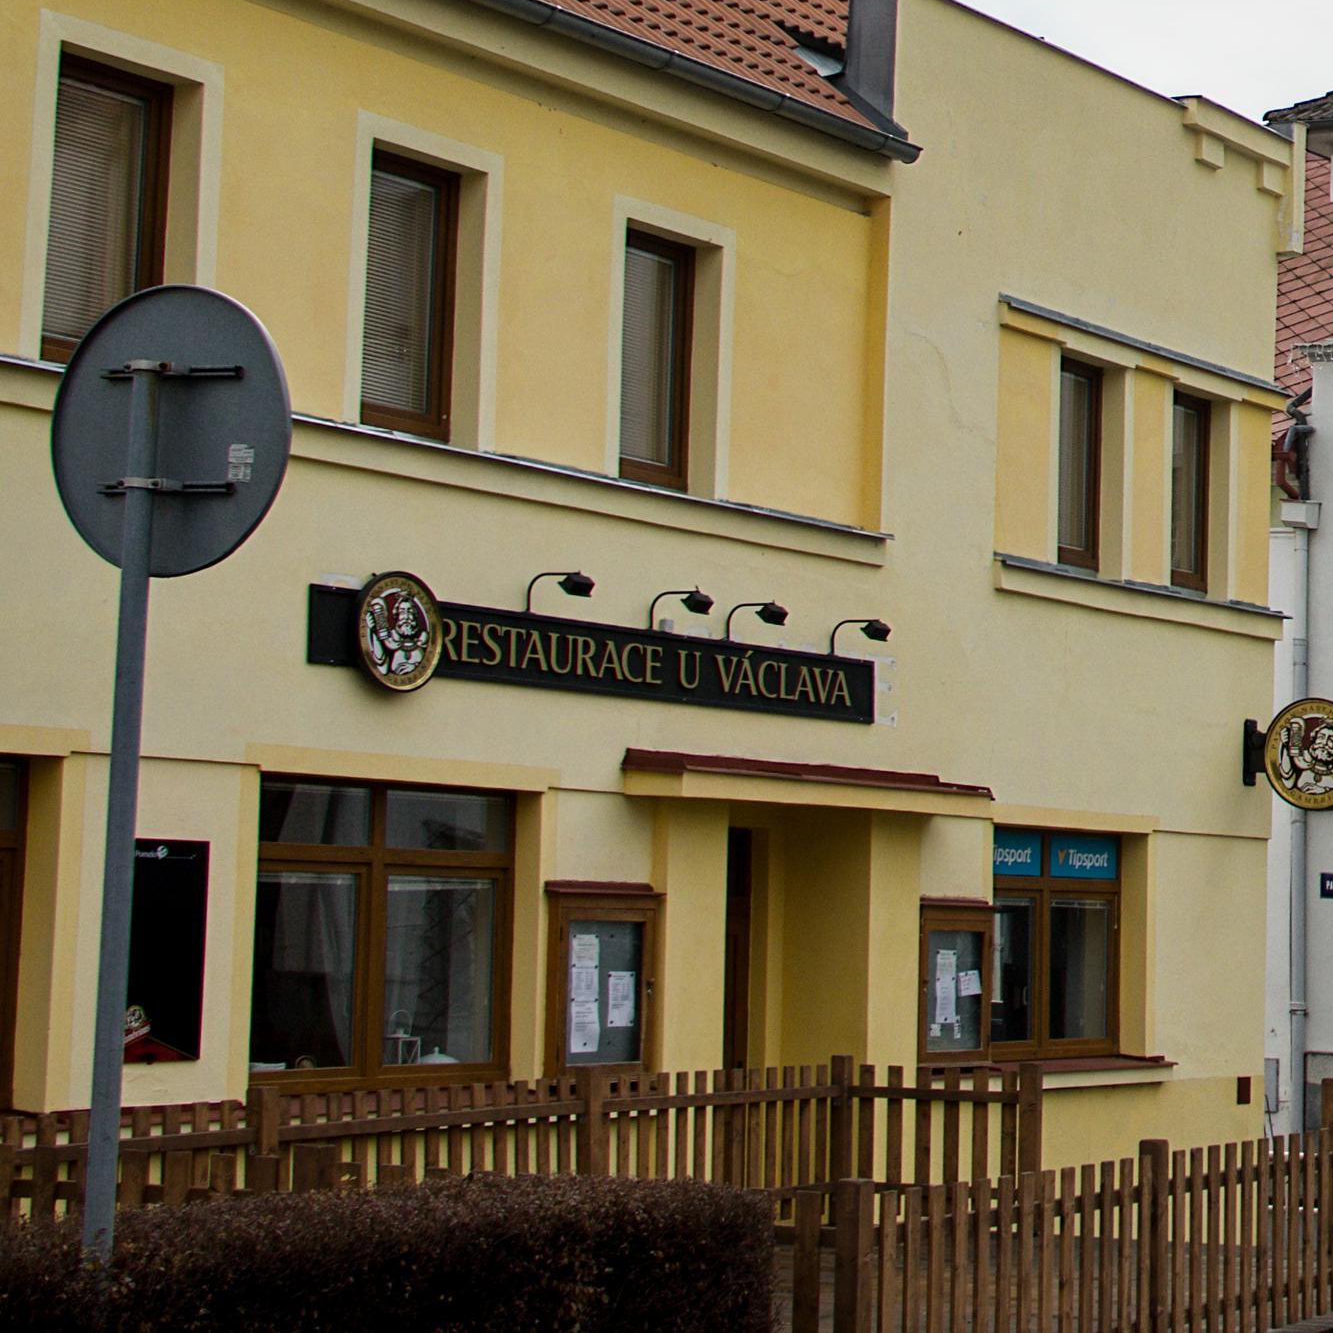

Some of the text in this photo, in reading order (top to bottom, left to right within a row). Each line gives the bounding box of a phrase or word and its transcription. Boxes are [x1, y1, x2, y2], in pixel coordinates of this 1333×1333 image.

[443, 618, 663, 684] RESTAURACE
[677, 650, 701, 689] U
[714, 650, 851, 707] VÁCLAVA
[992, 847, 1108, 869] ipsport Tipsport
